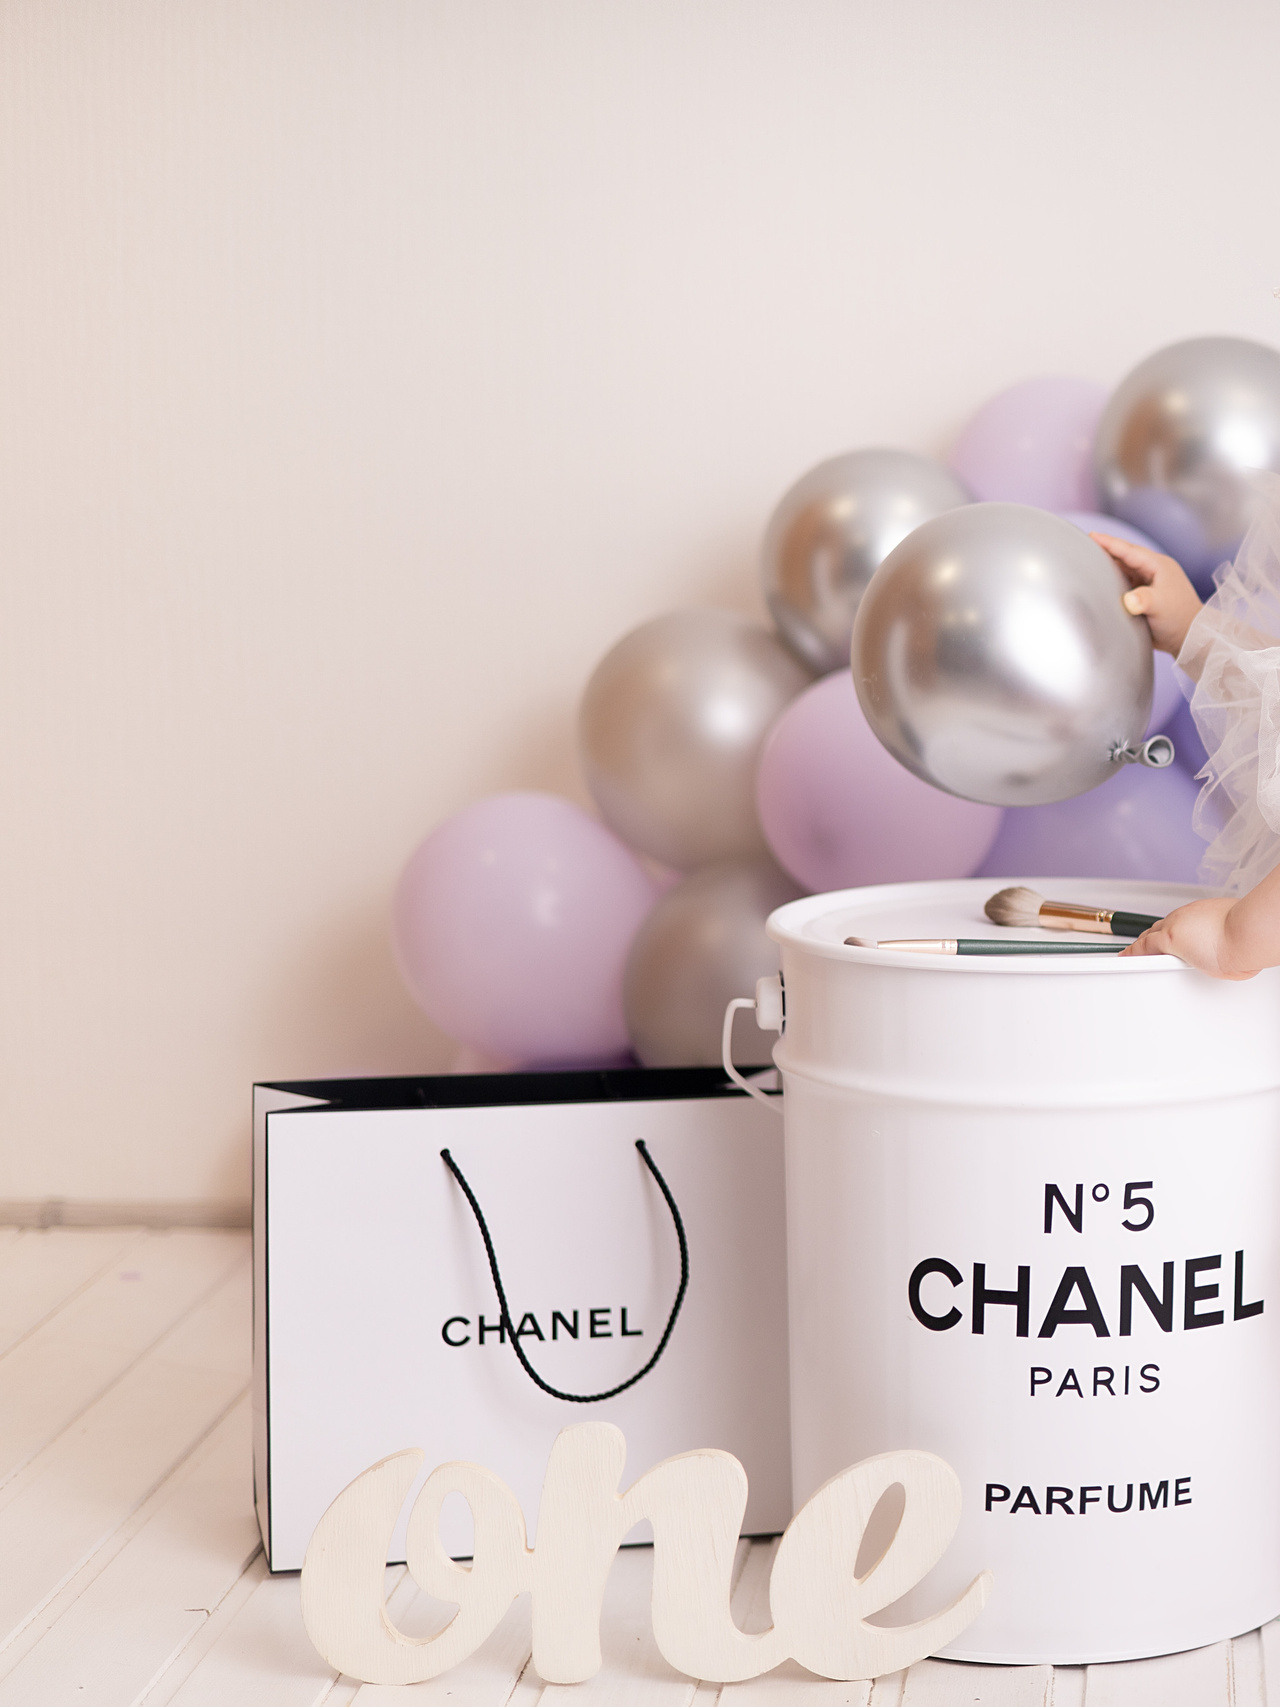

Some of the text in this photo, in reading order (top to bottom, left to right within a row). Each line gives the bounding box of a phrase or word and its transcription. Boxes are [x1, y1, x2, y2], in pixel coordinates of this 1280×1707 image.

[908, 1249, 1265, 1338] CHANEL
[441, 1306, 644, 1347] CHANEL
[1030, 1364, 1160, 1398] PARIS
[984, 1477, 1192, 1515] PARFUME
[300, 1421, 994, 1686] one
